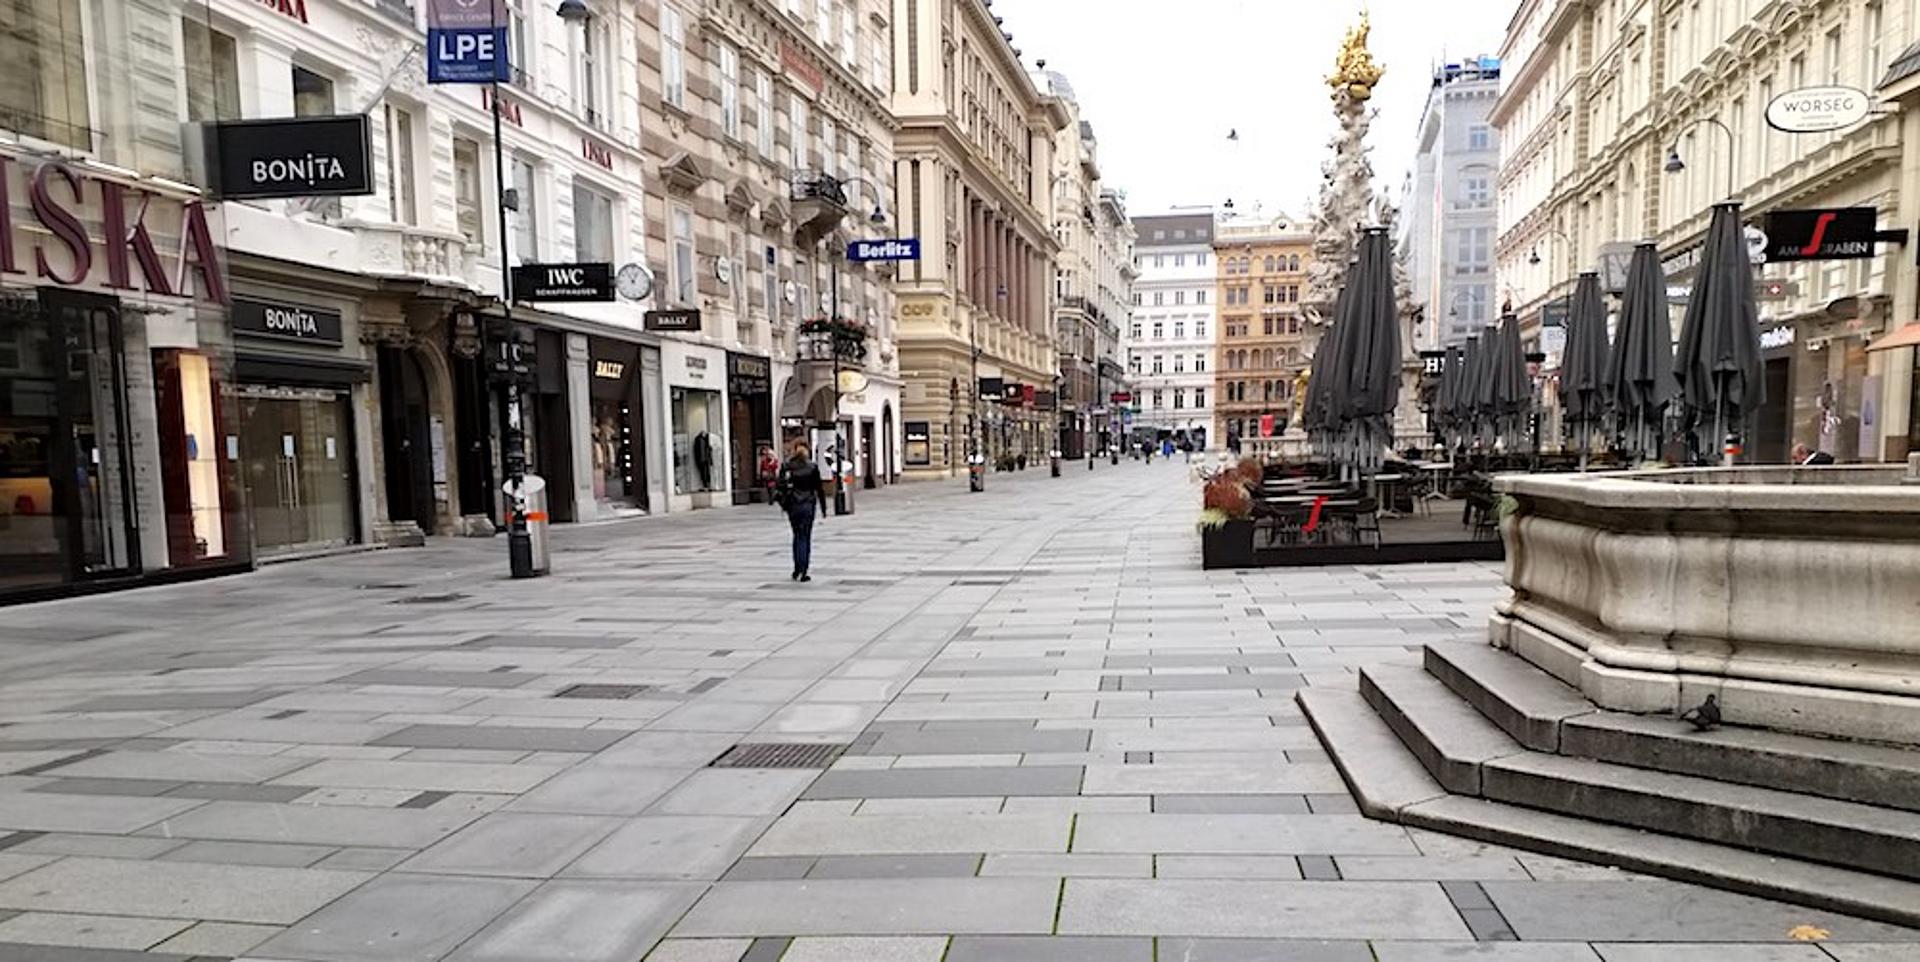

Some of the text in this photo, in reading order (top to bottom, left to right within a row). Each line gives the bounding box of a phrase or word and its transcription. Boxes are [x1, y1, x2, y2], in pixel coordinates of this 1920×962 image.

[439, 34, 494, 60] LPE
[1783, 98, 1854, 112] WORSEG
[858, 242, 912, 258] Berlitz
[1778, 245, 1799, 256] AM
[548, 268, 584, 285] IWC
[658, 316, 688, 325] BALLY
[595, 361, 624, 379] BALLY
